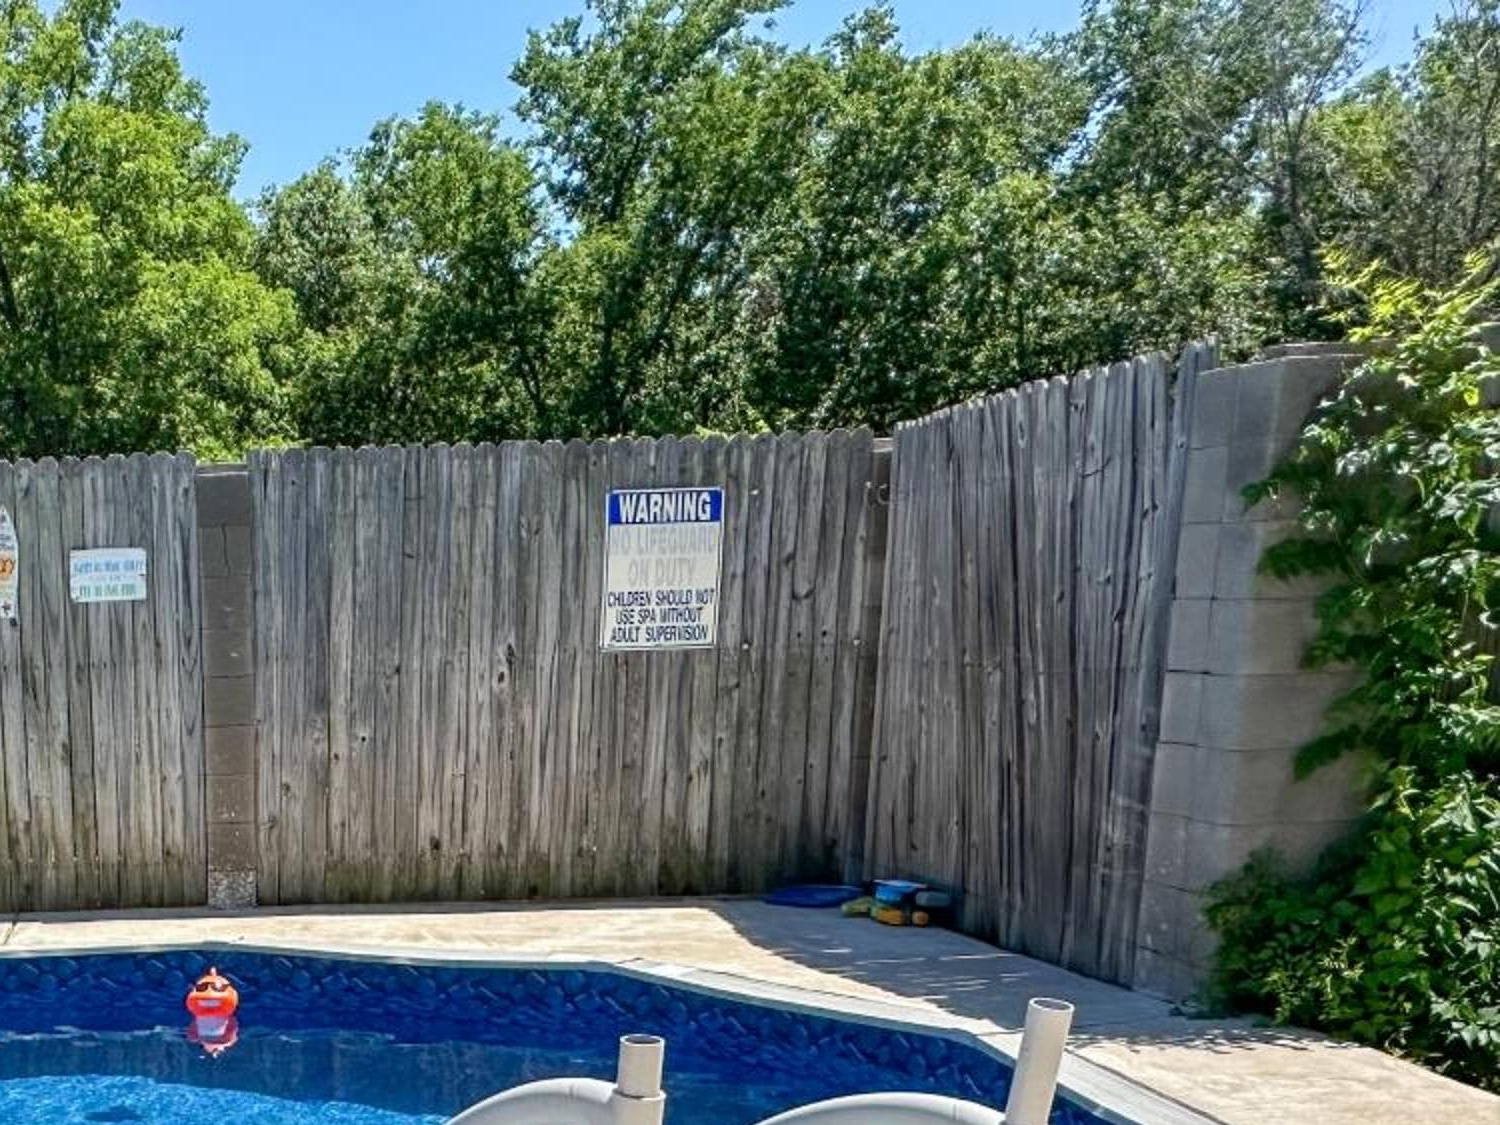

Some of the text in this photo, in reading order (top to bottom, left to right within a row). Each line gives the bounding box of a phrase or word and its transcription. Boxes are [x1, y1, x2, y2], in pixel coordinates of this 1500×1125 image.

[619, 492, 711, 523] WARNING
[607, 588, 715, 607] CHILDREN SHOULD NOT
[616, 606, 704, 625] USE SPA WITHOUT
[610, 624, 708, 642] ADULT SUPERVISION
